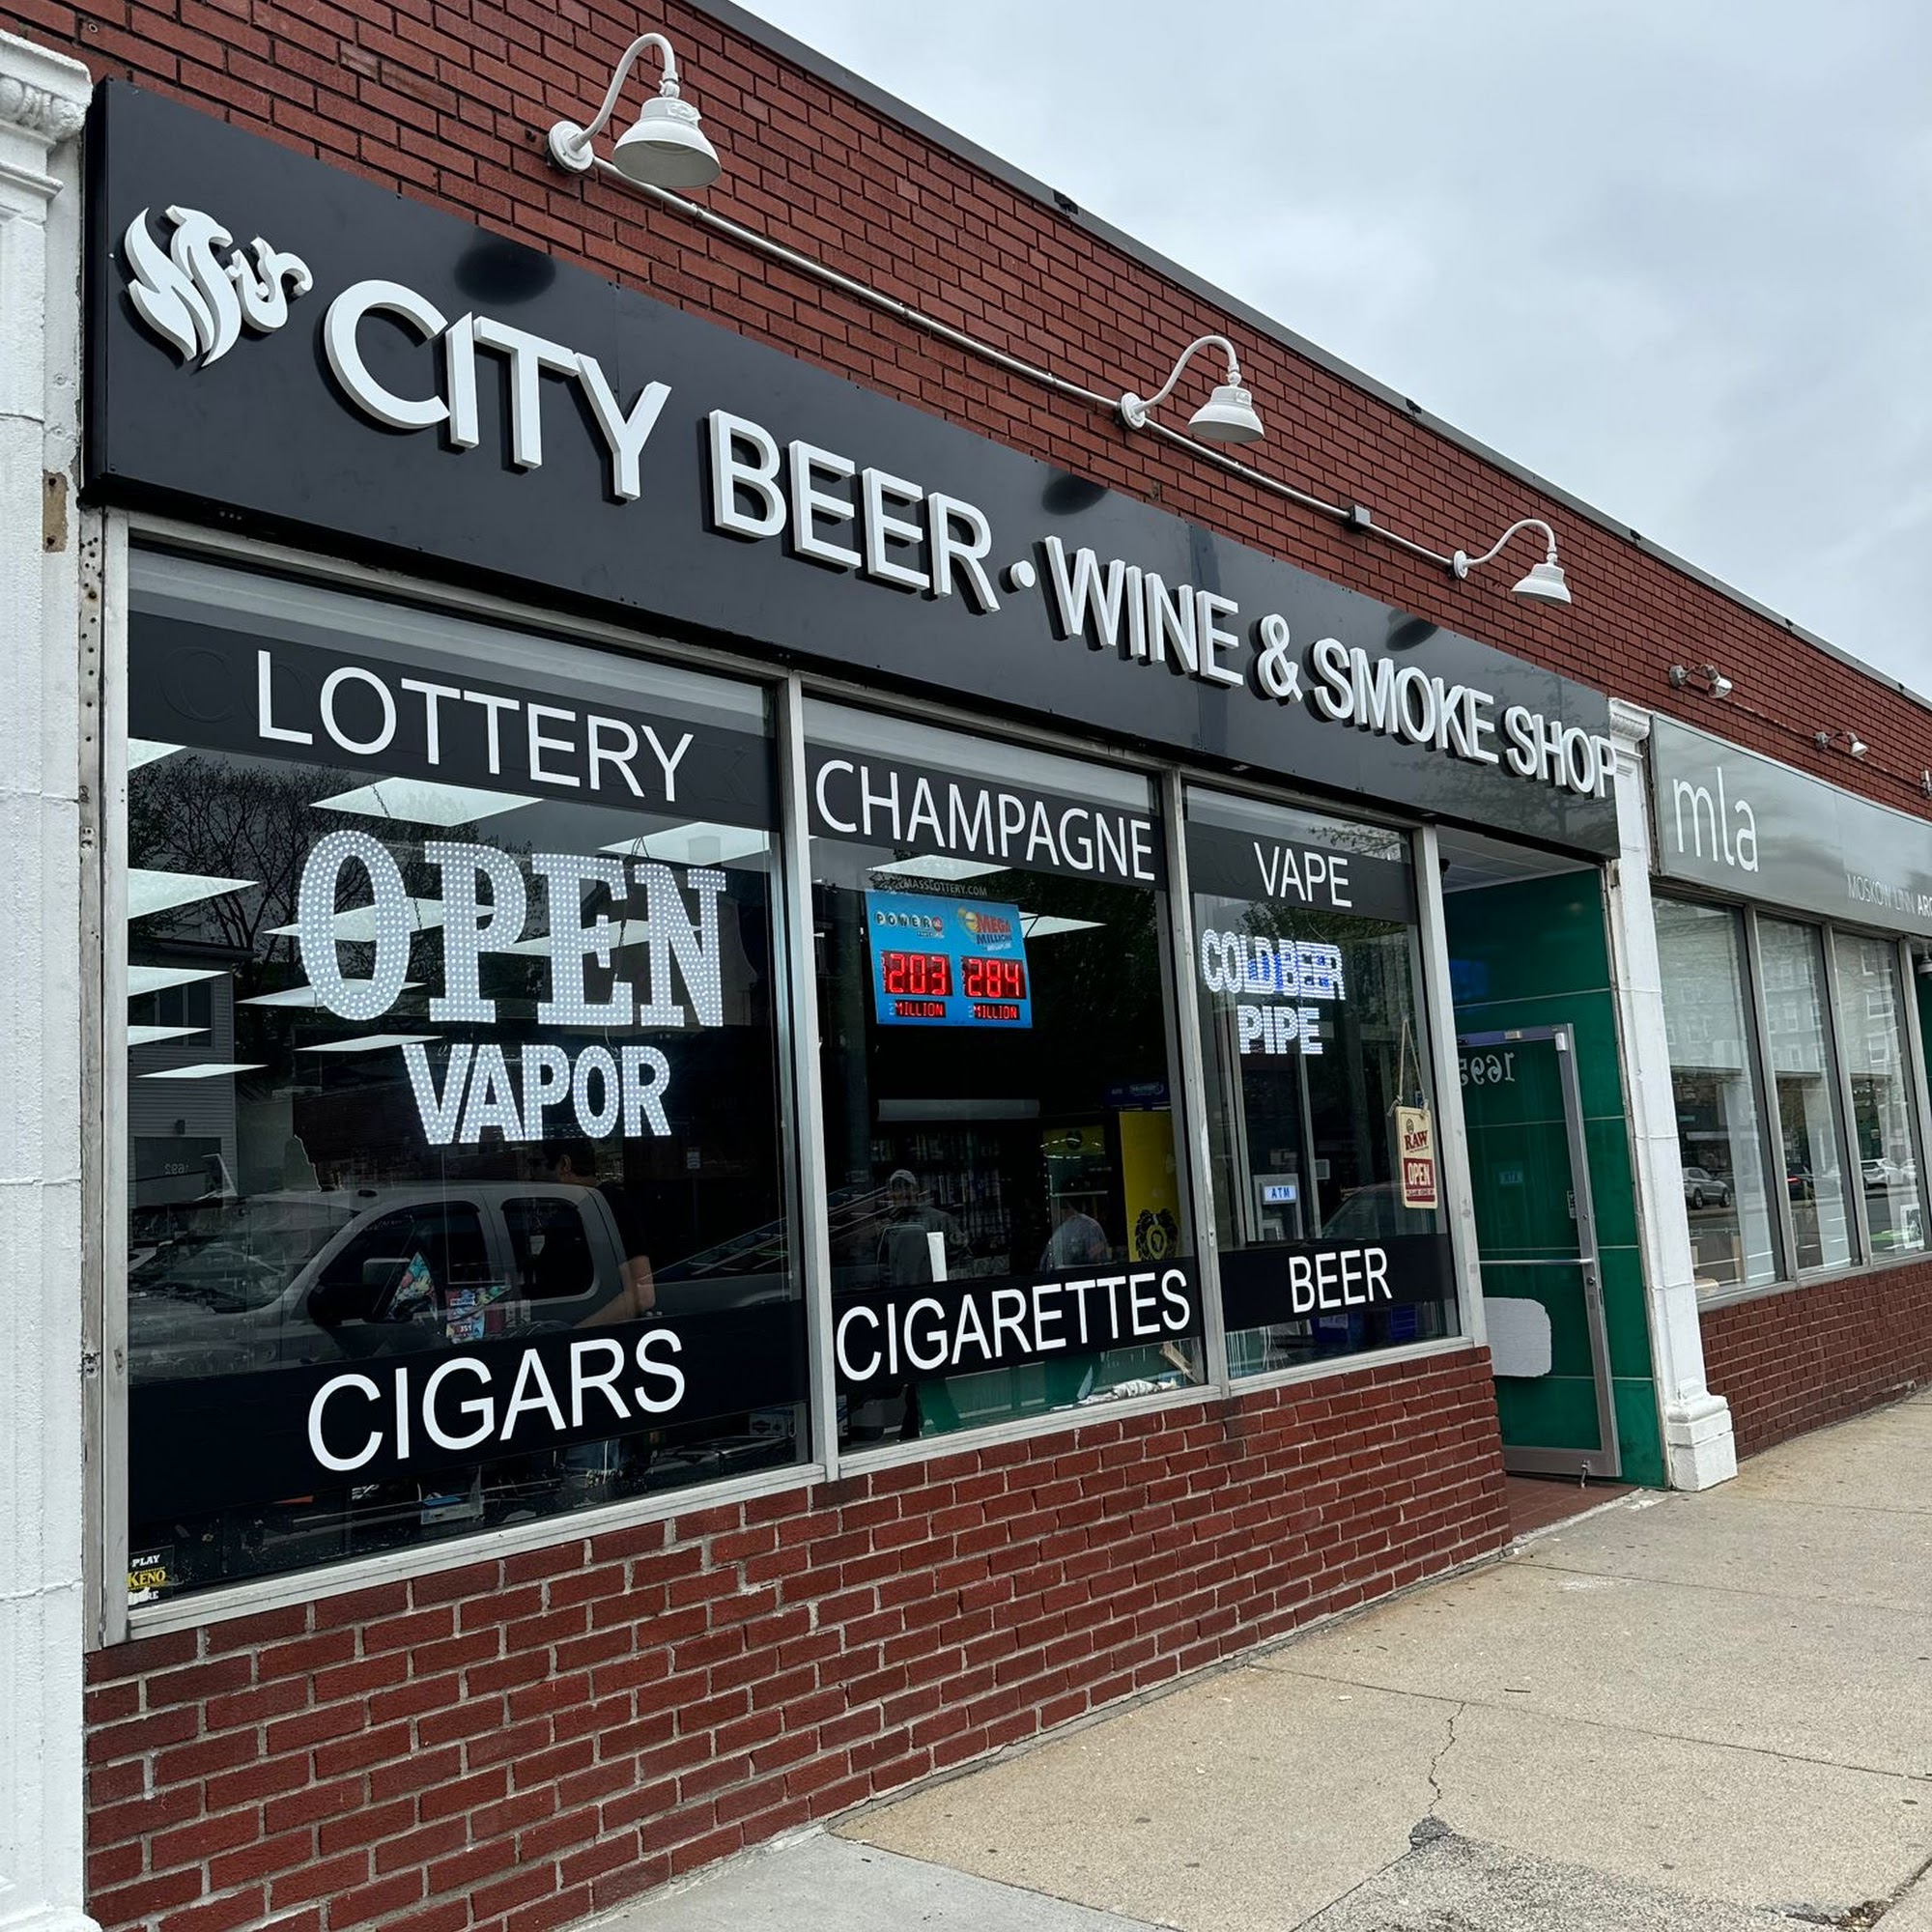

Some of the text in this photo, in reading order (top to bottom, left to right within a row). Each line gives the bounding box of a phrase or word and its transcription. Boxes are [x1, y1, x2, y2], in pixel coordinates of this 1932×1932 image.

[325, 280, 1619, 800] CITY BEER WINE & SMOKE SHOP
[259, 650, 694, 803] LOTTERY
[816, 759, 1155, 881] CHAMPAGNE
[1673, 766, 1759, 873] mla
[1253, 841, 1352, 908] VAPE
[297, 829, 726, 1028] OPEN
[975, 911, 1011, 933] MEGA
[888, 952, 947, 995] 203
[968, 958, 1020, 997] 284
[1202, 928, 1346, 1000] COLD BEER
[895, 1001, 944, 1017] MILLION
[974, 1004, 1017, 1019] MILLION
[1237, 1005, 1323, 1054] PIPE
[401, 1042, 672, 1146] VAPOR
[1404, 1130, 1429, 1151] RAW
[1271, 1186, 1291, 1199] ATM
[1406, 1162, 1432, 1186] OPEN
[1289, 1247, 1393, 1313] BEER
[837, 1268, 1190, 1381] CIGARETTES
[308, 1329, 685, 1471] CIGARS
[127, 1570, 166, 1588] KENO
[131, 1553, 160, 1568] PLAY
